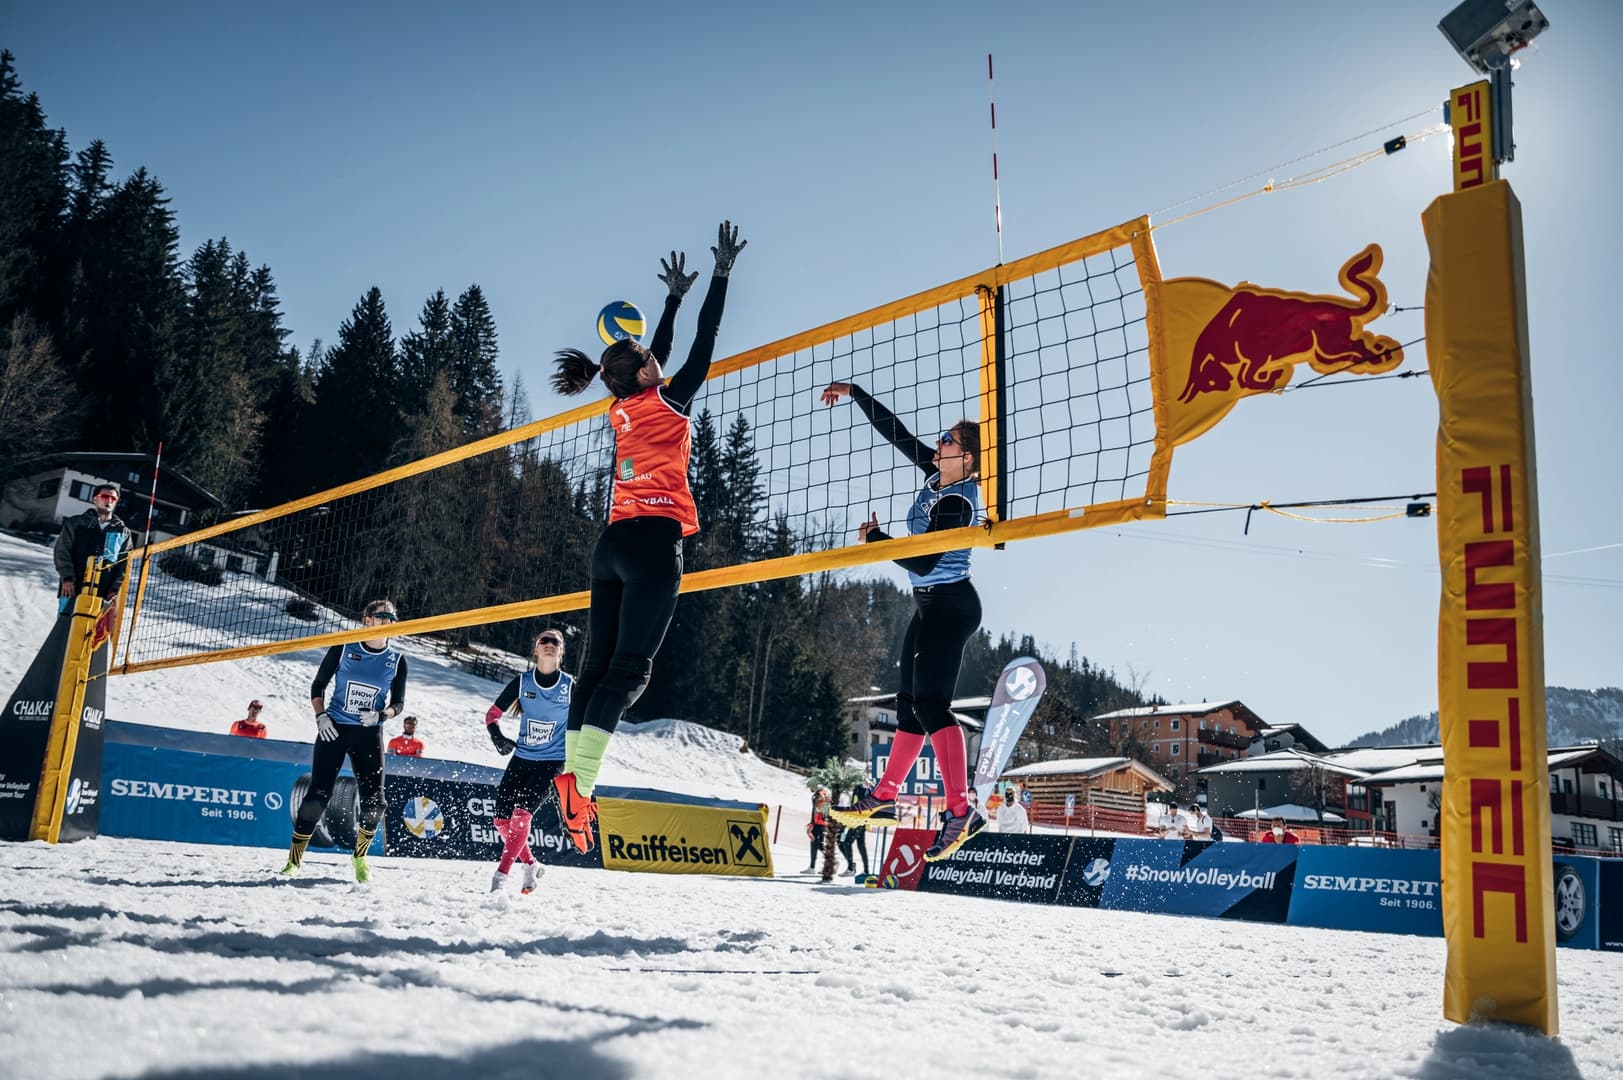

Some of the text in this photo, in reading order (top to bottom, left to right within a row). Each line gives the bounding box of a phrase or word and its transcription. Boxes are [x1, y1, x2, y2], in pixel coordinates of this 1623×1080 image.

[351, 690, 373, 698] SNOW
[560, 684, 568, 694] 3
[1461, 464, 1528, 943] FUNTEC
[111, 778, 257, 806] SEMPERIT
[201, 807, 257, 821] Seit 1906.
[467, 797, 497, 817] CE
[607, 834, 728, 865] Raiffeisen
[928, 866, 1057, 888] Volleyball Verband
[1125, 864, 1276, 891] #SnowVolleyball
[1303, 875, 1438, 897] SEMPERIT
[1379, 897, 1437, 910] Seit 1906.
